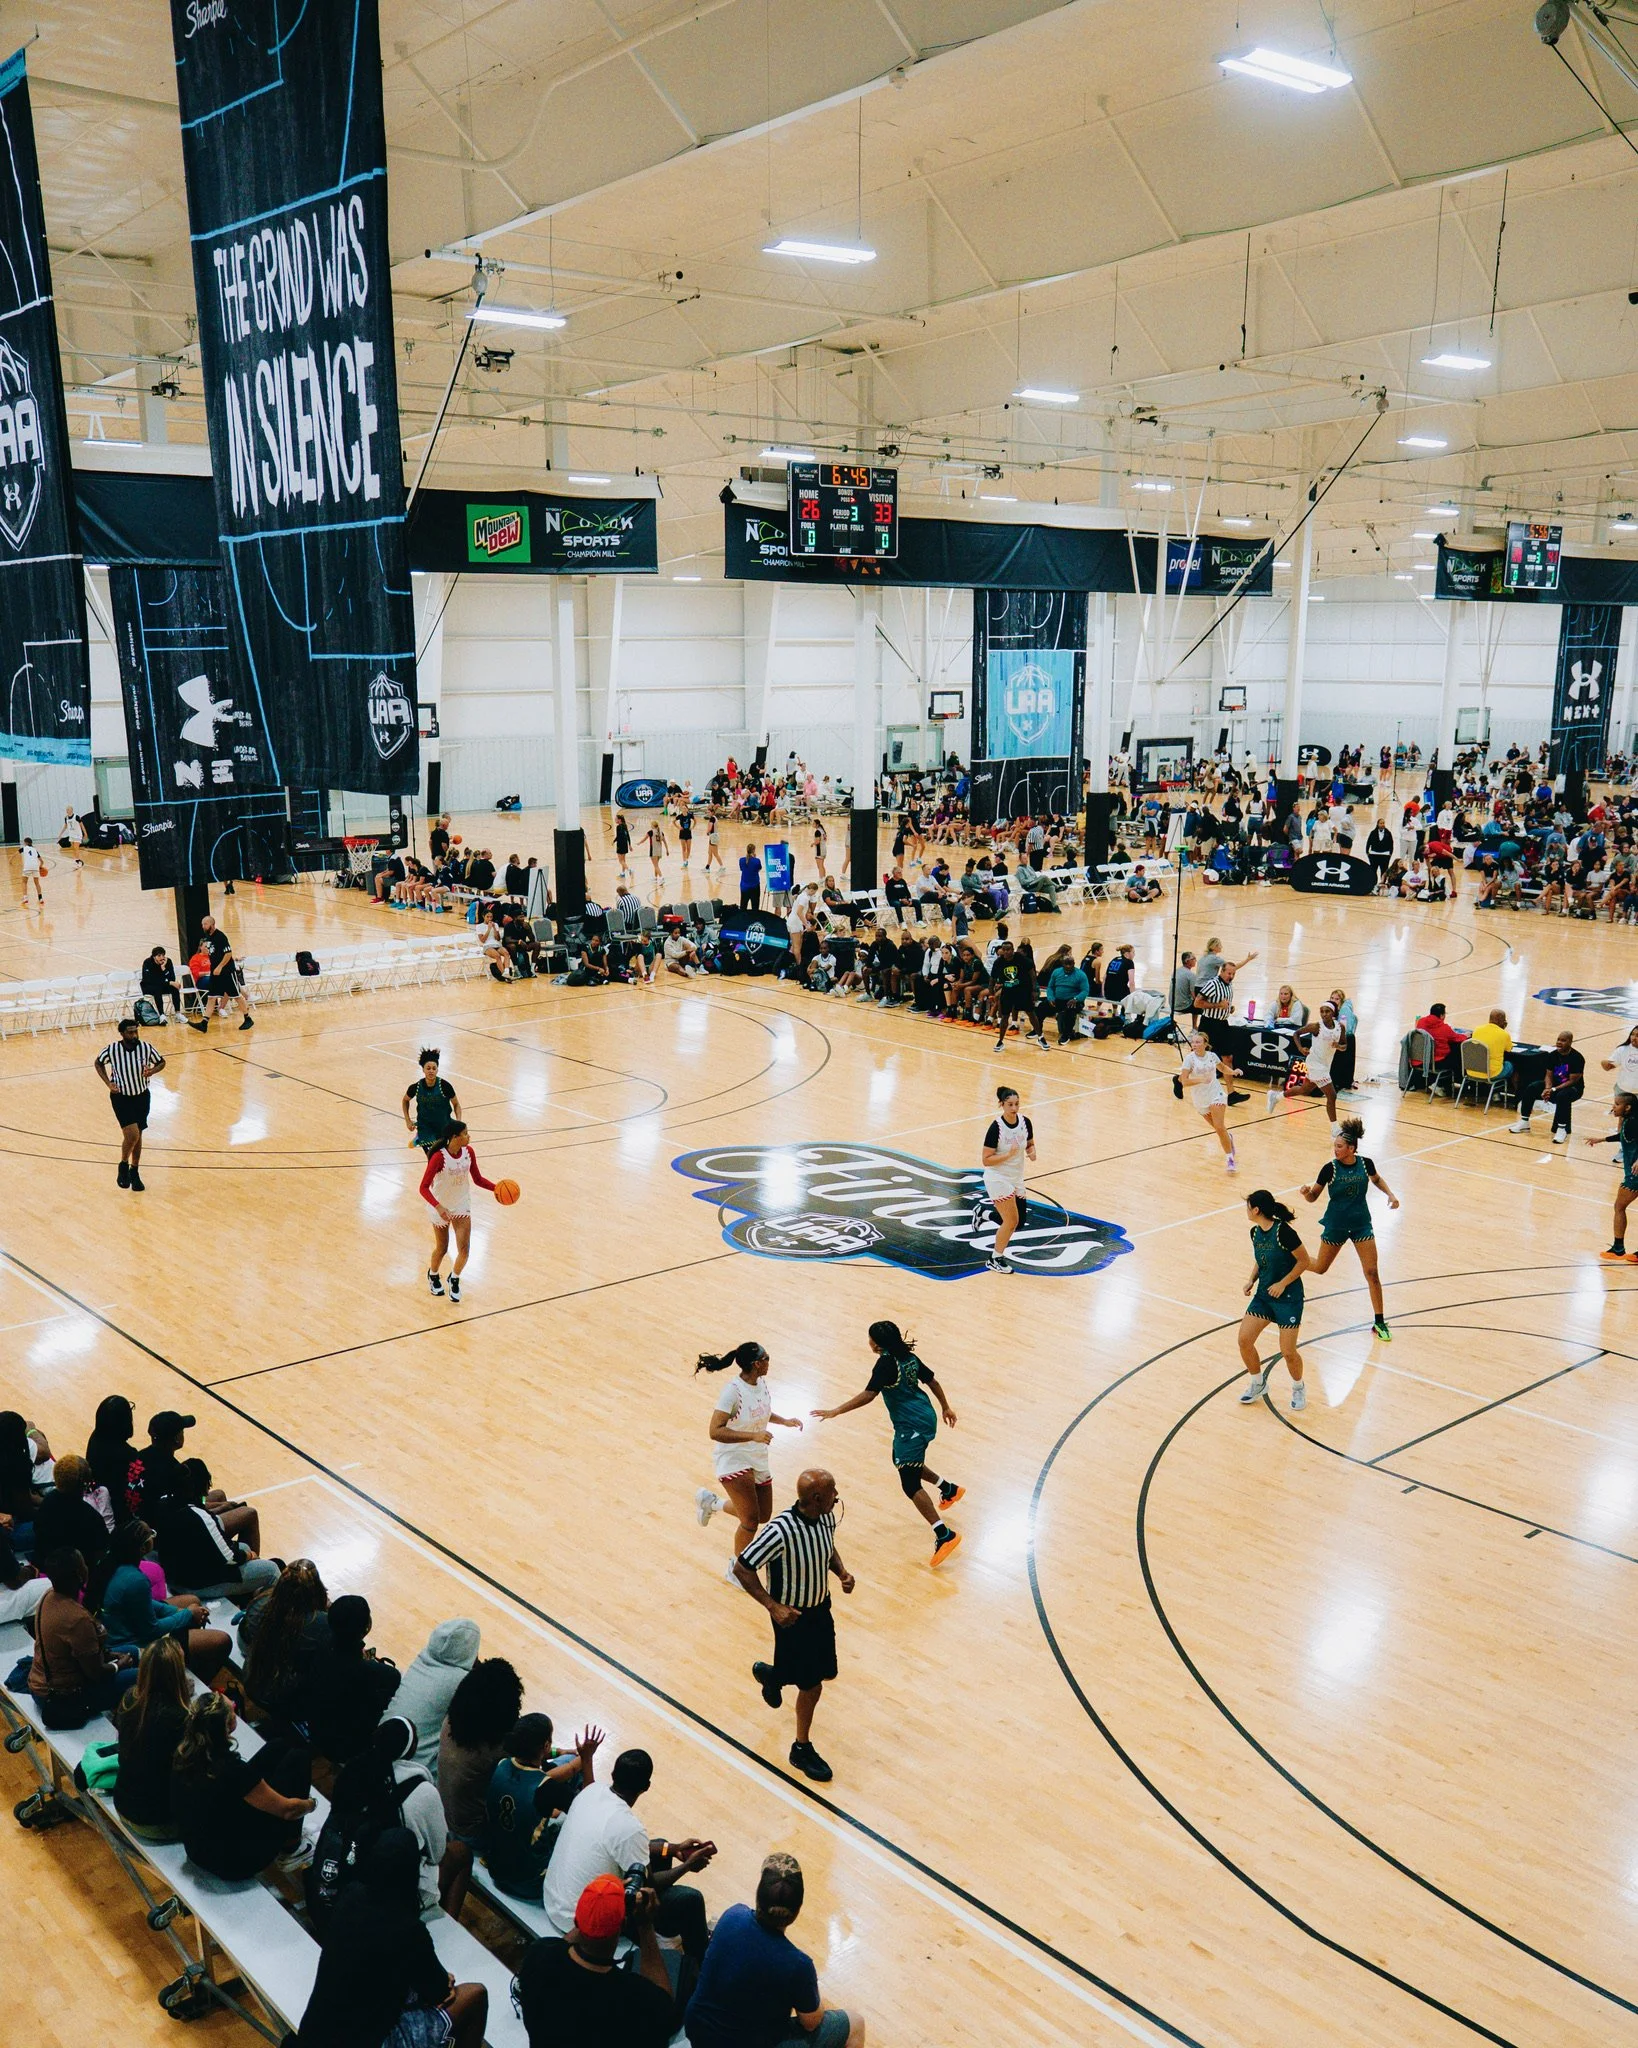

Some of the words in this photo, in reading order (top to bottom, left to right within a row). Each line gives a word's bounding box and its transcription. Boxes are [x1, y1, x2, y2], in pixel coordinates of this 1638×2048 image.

[213, 242, 250, 344] THE
[250, 218, 313, 333] GRIND
[312, 194, 369, 319] WAS
[0, 399, 40, 466] AA
[225, 372, 259, 519] IN
[255, 335, 380, 513] SILENCE
[832, 465, 868, 486] 6:45
[799, 489, 819, 499] HOME
[869, 493, 894, 503] VISITOR
[802, 500, 820, 520] 26
[851, 506, 858, 521] 3
[874, 503, 892, 523] 33
[562, 535, 621, 547] SPORTS
[808, 530, 815, 545] 0
[881, 533, 889, 548] 0
[567, 550, 601, 558] CHAMPION
[759, 544, 788, 556] SPO
[763, 558, 794, 567] CHAMPION
[1168, 557, 1202, 572] proel
[1453, 574, 1479, 582] SPORTS
[1007, 689, 1053, 715] UAA
[368, 698, 411, 725] UAA
[141, 820, 176, 838] Sharpie
[745, 930, 765, 942] UAA
[1247, 1061, 1267, 1069] UNDER
[1267, 1064, 1287, 1072] ARMO
[765, 1214, 868, 1252] UAA
